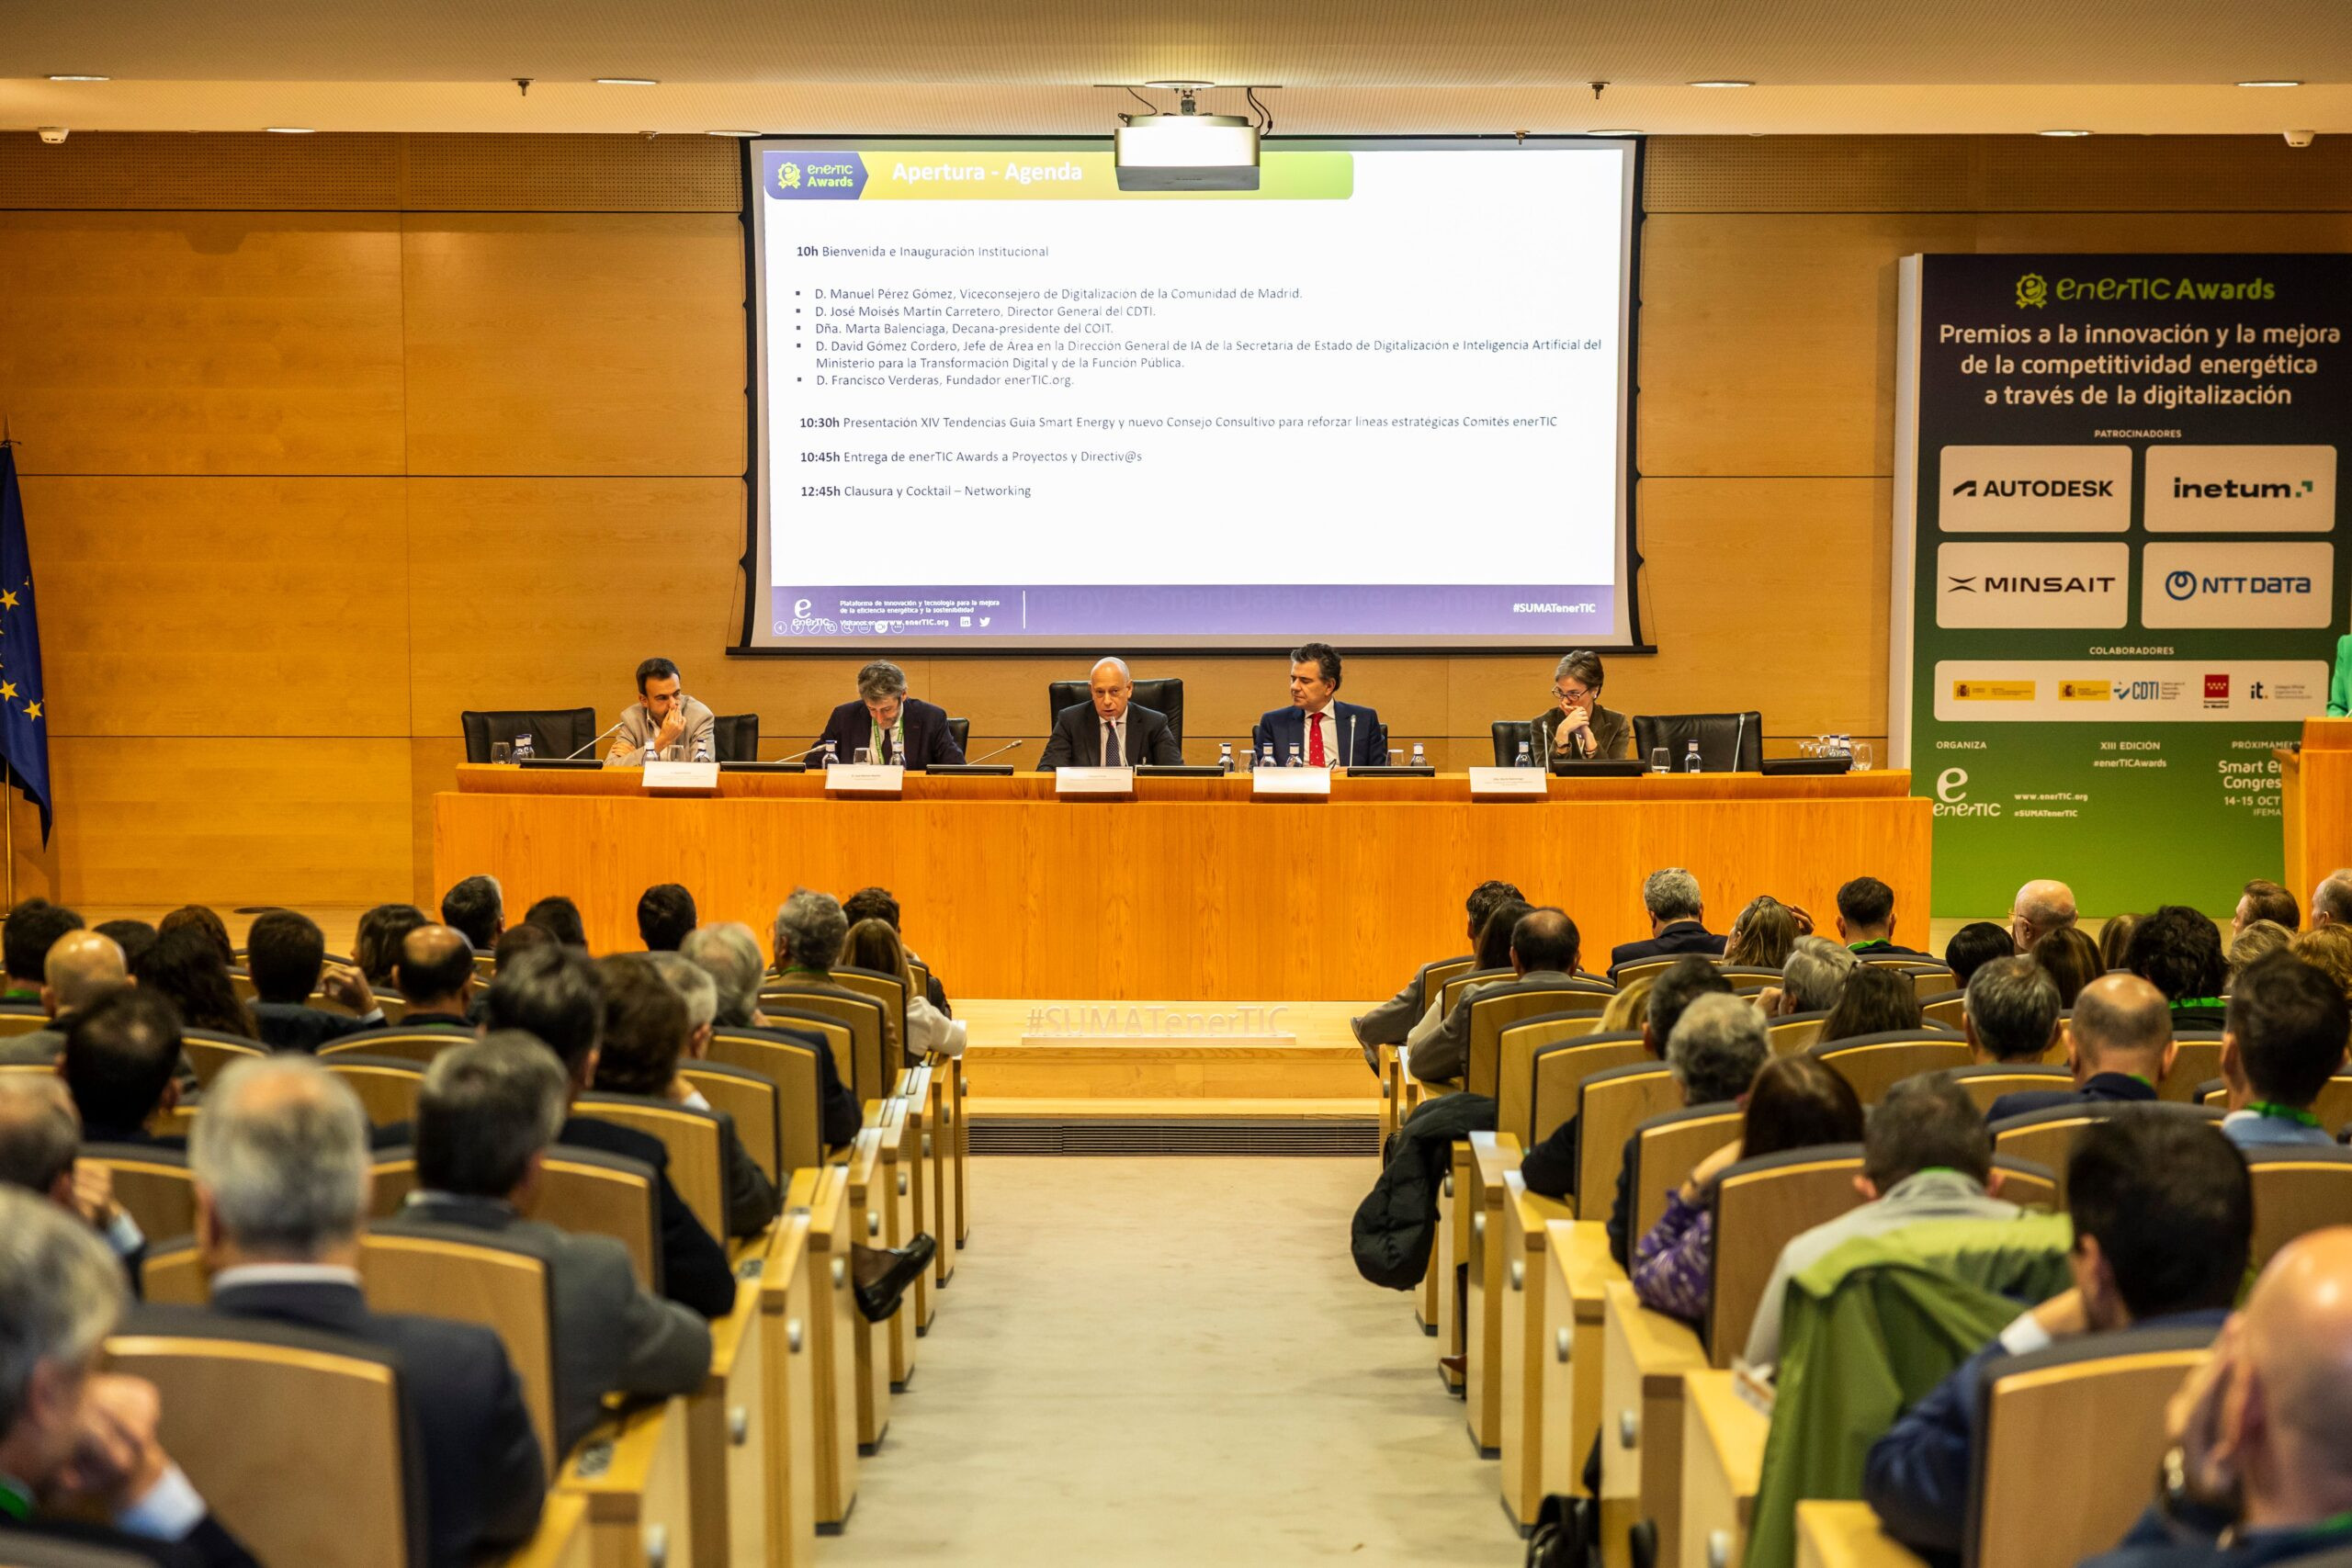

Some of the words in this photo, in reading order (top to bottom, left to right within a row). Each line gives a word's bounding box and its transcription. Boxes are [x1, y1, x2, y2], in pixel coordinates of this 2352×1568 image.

[807, 164, 854, 175] enerTIC
[891, 162, 986, 185] Apertura
[1003, 161, 1083, 185] Agenda
[807, 175, 854, 187] Awards
[797, 245, 819, 257] 10h
[822, 245, 887, 257] Bienvenida
[899, 245, 975, 260] Inauguración
[978, 245, 1049, 257] Institucional
[815, 288, 827, 299] D.
[830, 288, 875, 300] Manuel
[877, 288, 910, 300] Pérez
[911, 288, 956, 300] Gómez,
[959, 288, 1041, 302] Viceconsejero
[1061, 288, 1137, 302] Digitalización
[1170, 288, 1237, 299] Comunidad
[1258, 288, 1303, 299] Madrid.
[2055, 277, 2172, 301] enerTIC
[2174, 277, 2276, 300] Awards
[815, 306, 827, 317] D.
[830, 305, 855, 317] José
[858, 305, 900, 317] Moisés
[903, 305, 943, 317] Martín
[945, 306, 1004, 317] Carretero,
[1007, 306, 1054, 317] Director
[1057, 306, 1102, 317] General
[1105, 305, 1123, 317] del
[1125, 306, 1157, 317] CDTI.
[815, 322, 842, 334] Dña.
[845, 322, 881, 334] Marta
[884, 322, 949, 337] Balenciaga,
[952, 322, 1061, 336] Decana-presidente
[1063, 322, 1081, 334] del
[1084, 322, 1114, 334] COIT.
[1939, 323, 2032, 344] Premios
[2037, 328, 2052, 344] a
[2058, 322, 2079, 344] la
[2085, 322, 2210, 344] innovación
[2215, 327, 2230, 349] y
[2235, 322, 2256, 344] la
[2263, 322, 2341, 348] mejora
[815, 340, 828, 352] D.
[831, 340, 864, 352] David
[866, 340, 907, 352] Gómez
[910, 340, 960, 353] Cordero,
[962, 339, 986, 352] Jefe
[1006, 338, 1034, 352] Área
[1068, 340, 1122, 352] Dirección
[1124, 340, 1170, 352] General
[1172, 339, 1188, 352] de
[1190, 340, 1203, 351] IA
[1204, 339, 1220, 352] de
[1223, 340, 1233, 351] la
[1296, 339, 1311, 352] de
[1315, 339, 1353, 352] Estado
[1355, 339, 1371, 351] de
[1374, 339, 1450, 354] Digitalización
[1452, 342, 1460, 351] e
[1463, 339, 1530, 354] Inteligencia
[1532, 338, 1581, 351] Artificial
[1583, 338, 1601, 351] del
[816, 357, 876, 368] Ministerio
[877, 359, 904, 371] para
[907, 356, 917, 368] la
[920, 356, 1010, 368] Transformación
[1012, 356, 1048, 371] Digital
[1051, 359, 1058, 371] y
[1061, 357, 1076, 368] de
[1079, 356, 1089, 368] la
[1092, 357, 1137, 368] Función
[1140, 356, 1184, 368] Pública.
[1960, 354, 1989, 375] de
[1995, 354, 2015, 375] la
[2020, 354, 2191, 379] competitividad
[2199, 354, 2318, 379] energética
[816, 374, 829, 386] D.
[831, 374, 886, 387] Francisco
[888, 374, 943, 387] Verderas,
[945, 374, 1001, 386] Fundador
[1004, 374, 1074, 389] enerTIC.org.
[1984, 389, 1998, 405] a
[2003, 384, 2075, 405] través
[2080, 384, 2109, 405] de
[2117, 384, 2137, 405] la
[2143, 383, 2292, 411] digitalización
[799, 416, 841, 429] 10:30h
[842, 416, 918, 429] Presentación
[920, 416, 941, 428] XIV
[942, 416, 1007, 428] Tendencias
[1038, 416, 1073, 428] Smart
[1076, 416, 1115, 431] Energy
[1118, 419, 1125, 430] y
[1128, 418, 1164, 427] nuevo
[1166, 416, 1213, 431] Consejo
[1216, 416, 1276, 427] Consultivo
[1278, 418, 1304, 430] para
[1307, 415, 1352, 427] reforzar
[1391, 416, 1460, 430] estratégicas
[1462, 416, 1510, 427] Comités
[1512, 416, 1558, 427] enerTIC
[2094, 429, 2182, 438] PATROCINADORES
[800, 451, 841, 463] 10:45h
[843, 451, 888, 466] Entrega
[890, 451, 906, 462] de
[909, 451, 954, 462] enerTIC
[956, 450, 999, 462] Awards
[1001, 453, 1009, 462] a
[1012, 451, 1069, 464] Proyectos
[1070, 453, 1078, 464] y
[1080, 450, 1143, 464] Directiv@s
[800, 485, 841, 497] 12:45h
[843, 485, 894, 497] Clausura
[896, 488, 903, 499] y
[905, 485, 951, 497] Cocktail
[965, 484, 1032, 499] Networking
[1982, 479, 2114, 498] AUTODESK
[1984, 576, 2117, 593] MINSAIT
[2201, 576, 2248, 594] NTT
[1512, 603, 1596, 614] #SUMATenerTIC
[2088, 646, 2175, 656] COLABORADORES
[2132, 681, 2159, 700] CDTI
[1936, 740, 1987, 750] ORGANIZA
[2099, 741, 2118, 750] XIII
[2119, 739, 2161, 750] EDICIÓN
[2092, 758, 2167, 768] #enerTICAwards
[2218, 760, 2264, 773] Smart
[2222, 775, 2282, 792] Congres
[2013, 792, 2089, 803] www.enerTIC.org
[2223, 795, 2254, 806] 14-15
[2257, 795, 2281, 806] OCT
[1932, 802, 2002, 817] enerTIC
[2013, 809, 2079, 818] #SUMATenerTIC
[2253, 807, 2282, 817] IFEMA
[1026, 1005, 1290, 1036] #SUMATenerTIC
